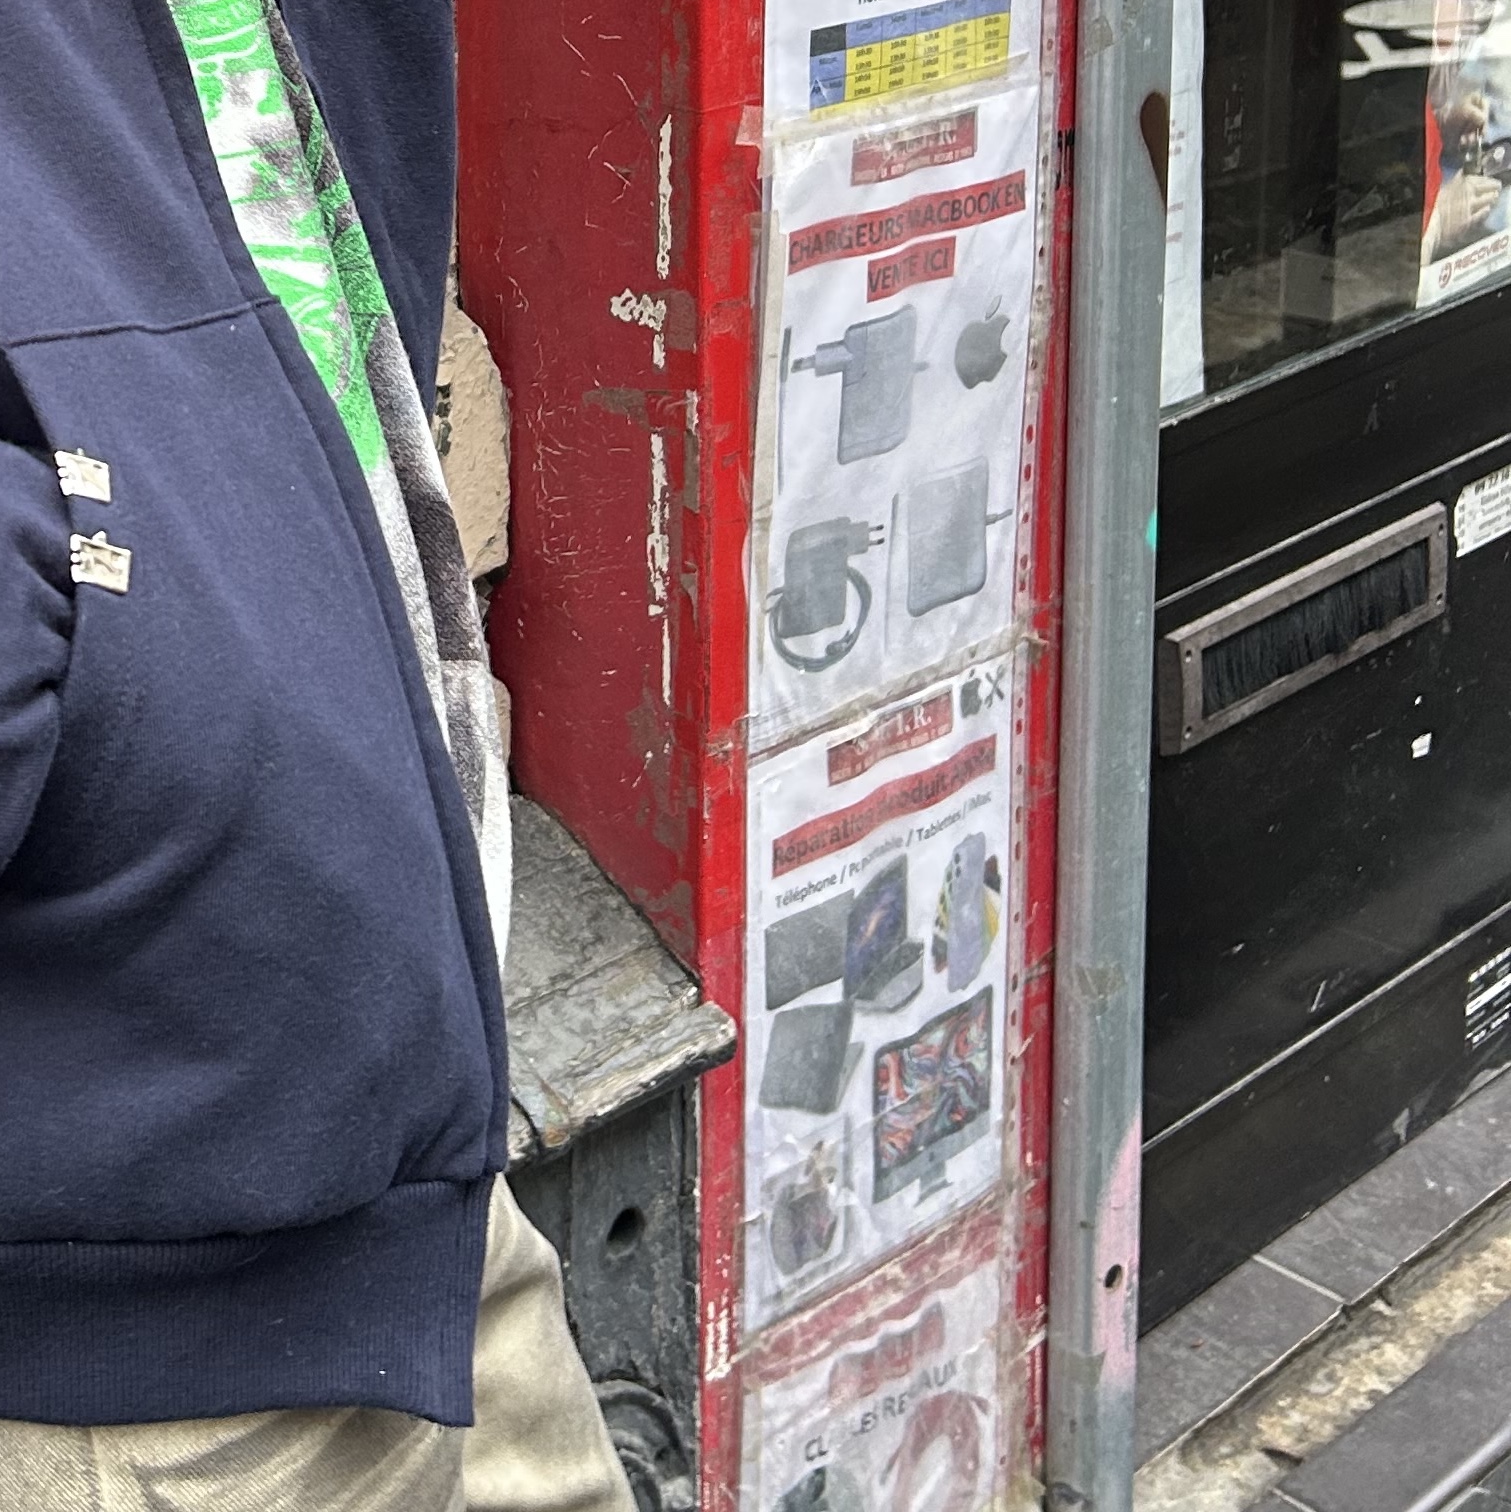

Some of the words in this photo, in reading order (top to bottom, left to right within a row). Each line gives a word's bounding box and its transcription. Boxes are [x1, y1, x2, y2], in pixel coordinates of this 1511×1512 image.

[789, 213, 904, 265] CHARGEURS
[906, 191, 999, 228] MACBOOK
[1004, 182, 1025, 207] EN
[868, 255, 918, 292] VENTE
[924, 247, 949, 273] ICI
[776, 873, 837, 908] Téléphone
